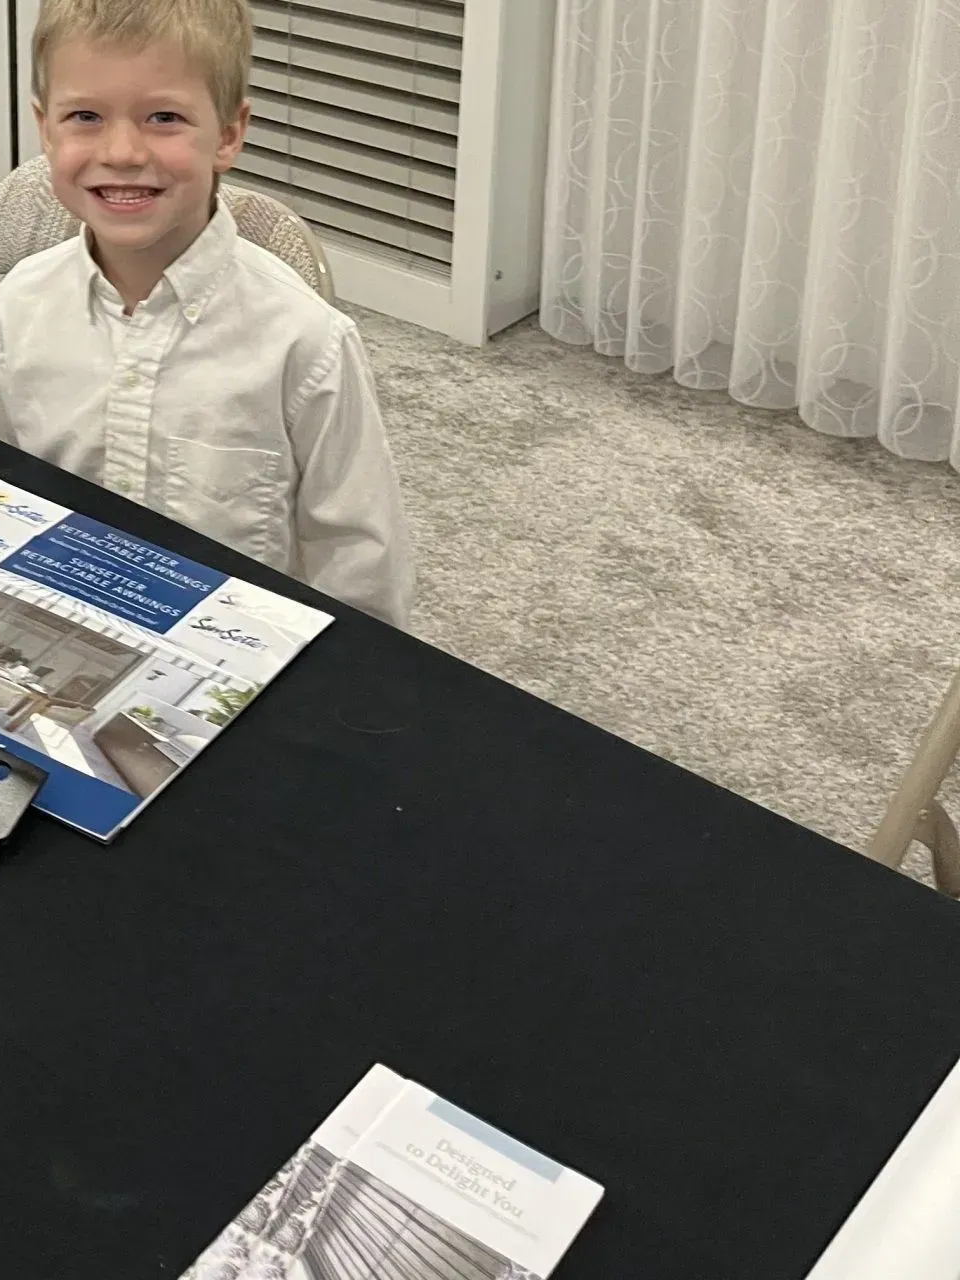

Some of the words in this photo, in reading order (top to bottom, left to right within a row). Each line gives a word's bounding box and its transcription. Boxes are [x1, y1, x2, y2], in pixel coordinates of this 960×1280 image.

[56, 523, 146, 564] RETRACTABLE
[144, 561, 212, 593] AWNINGS
[70, 557, 147, 592] SUNSETTER
[105, 532, 180, 568] SUNSETTER
[20, 548, 112, 589] RETRACTABLE
[111, 586, 182, 618] AWNINGS
[406, 1143, 425, 1159] to
[426, 1152, 490, 1199] Delight
[491, 1190, 525, 1220] You
[435, 1137, 518, 1192] Designed
